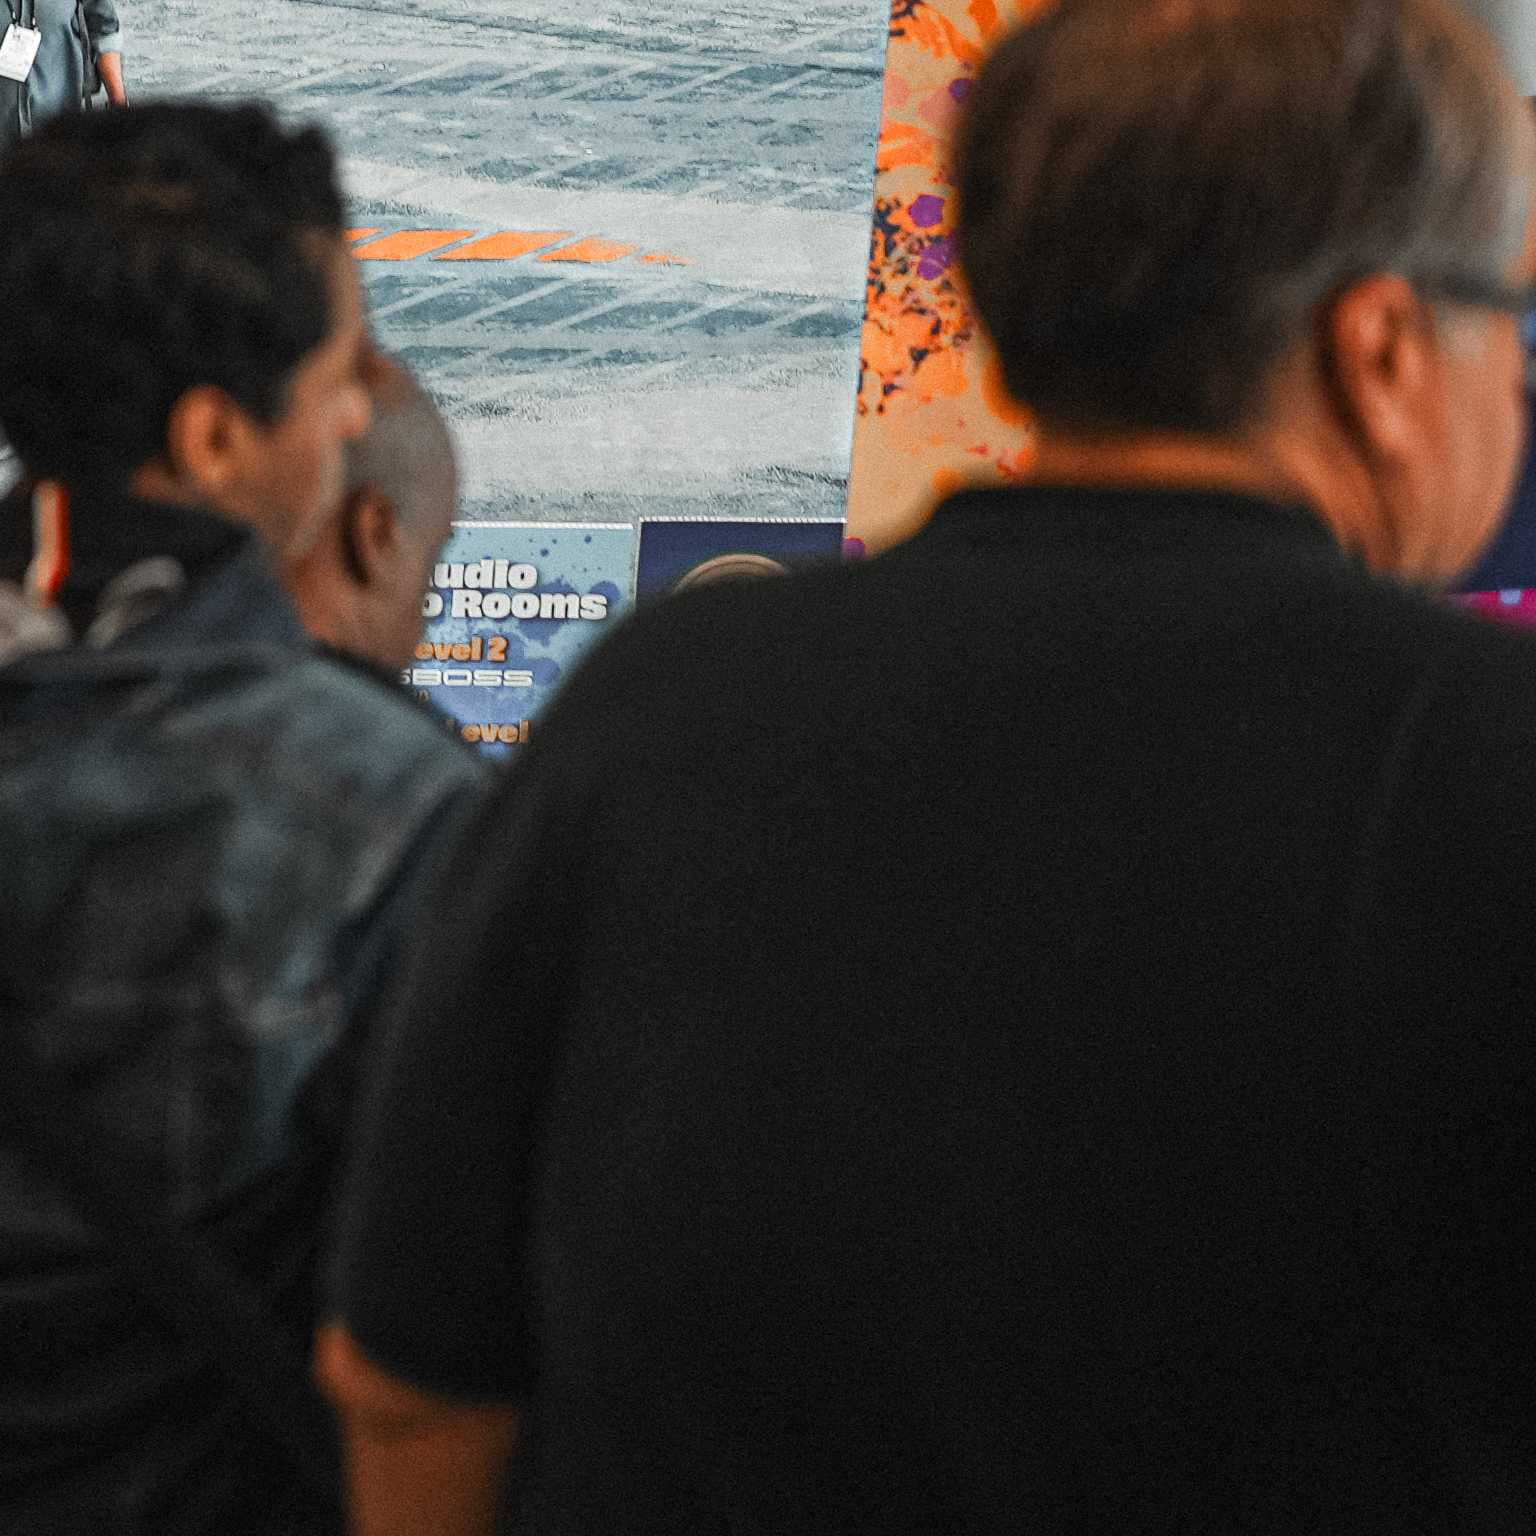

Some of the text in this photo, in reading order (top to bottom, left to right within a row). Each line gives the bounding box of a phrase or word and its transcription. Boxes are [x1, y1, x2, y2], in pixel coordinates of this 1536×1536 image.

[430, 558, 538, 589] udio
[450, 590, 608, 620] Rooms
[415, 634, 508, 662] evel 2
[461, 719, 530, 745] evel
